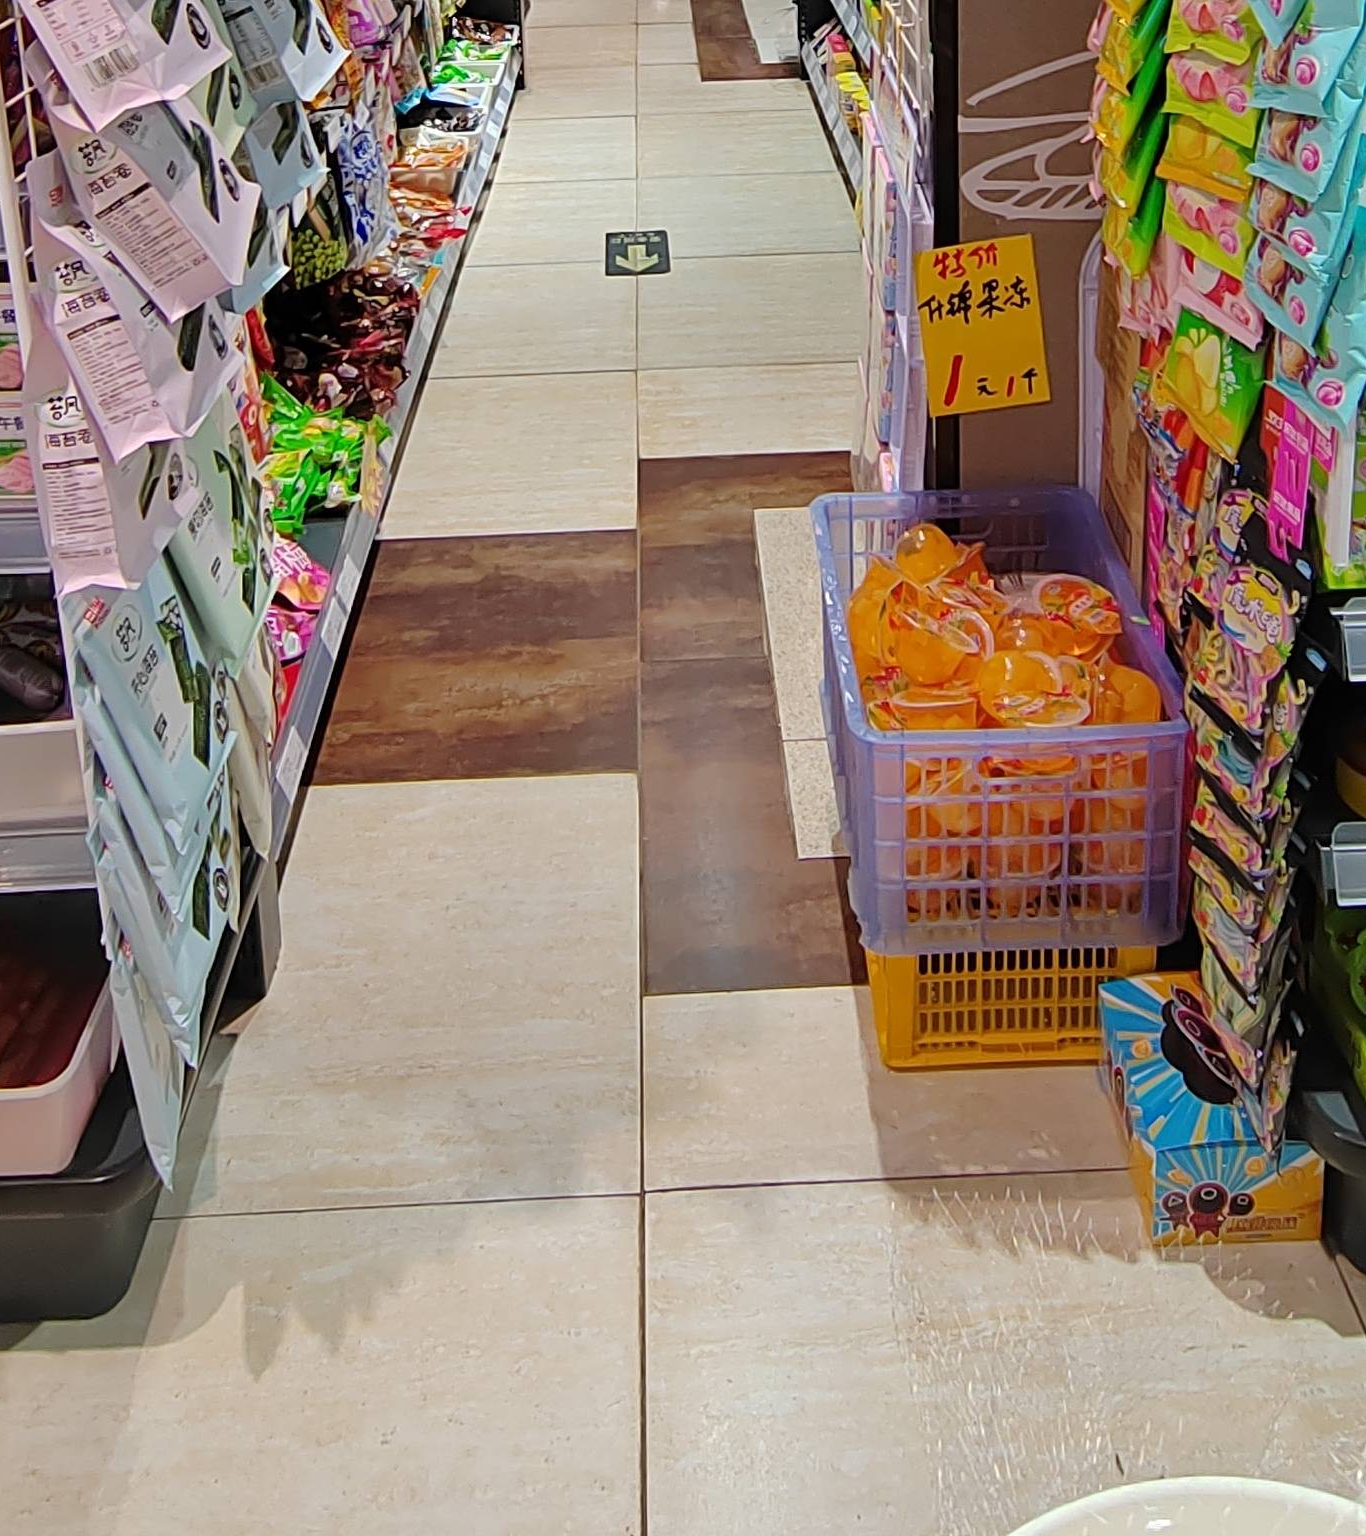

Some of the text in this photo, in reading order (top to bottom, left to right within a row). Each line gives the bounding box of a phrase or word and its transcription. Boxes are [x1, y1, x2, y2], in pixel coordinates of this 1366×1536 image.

[933, 242, 999, 280] 特价
[919, 277, 1032, 324] 什锦果冻
